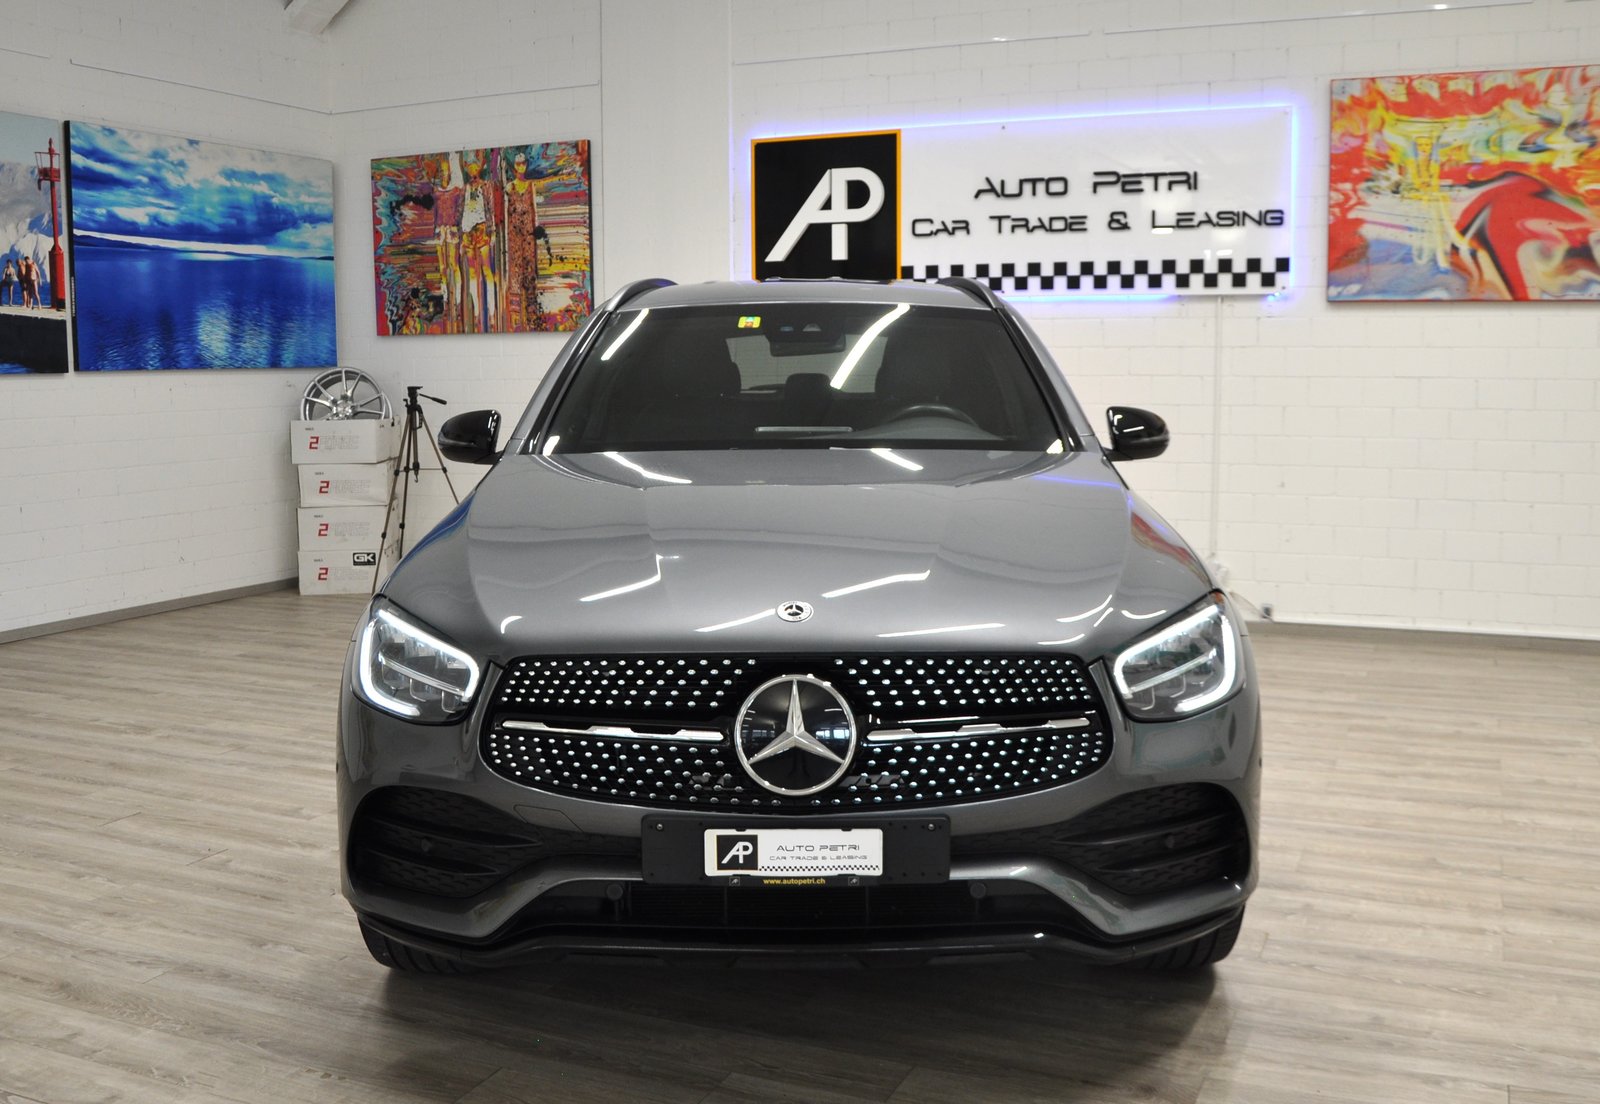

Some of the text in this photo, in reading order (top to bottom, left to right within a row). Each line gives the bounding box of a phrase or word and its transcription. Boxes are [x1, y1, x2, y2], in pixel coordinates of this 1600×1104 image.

[973, 170, 1198, 199] AUTO PETRI
[764, 167, 886, 262] AP
[911, 209, 1285, 237] CAR TRADE & LEASING
[354, 553, 375, 562] GK
[721, 841, 754, 864] AP
[776, 844, 860, 852] AUTO PETRI
[763, 878, 826, 886] www.autopetri.ch
